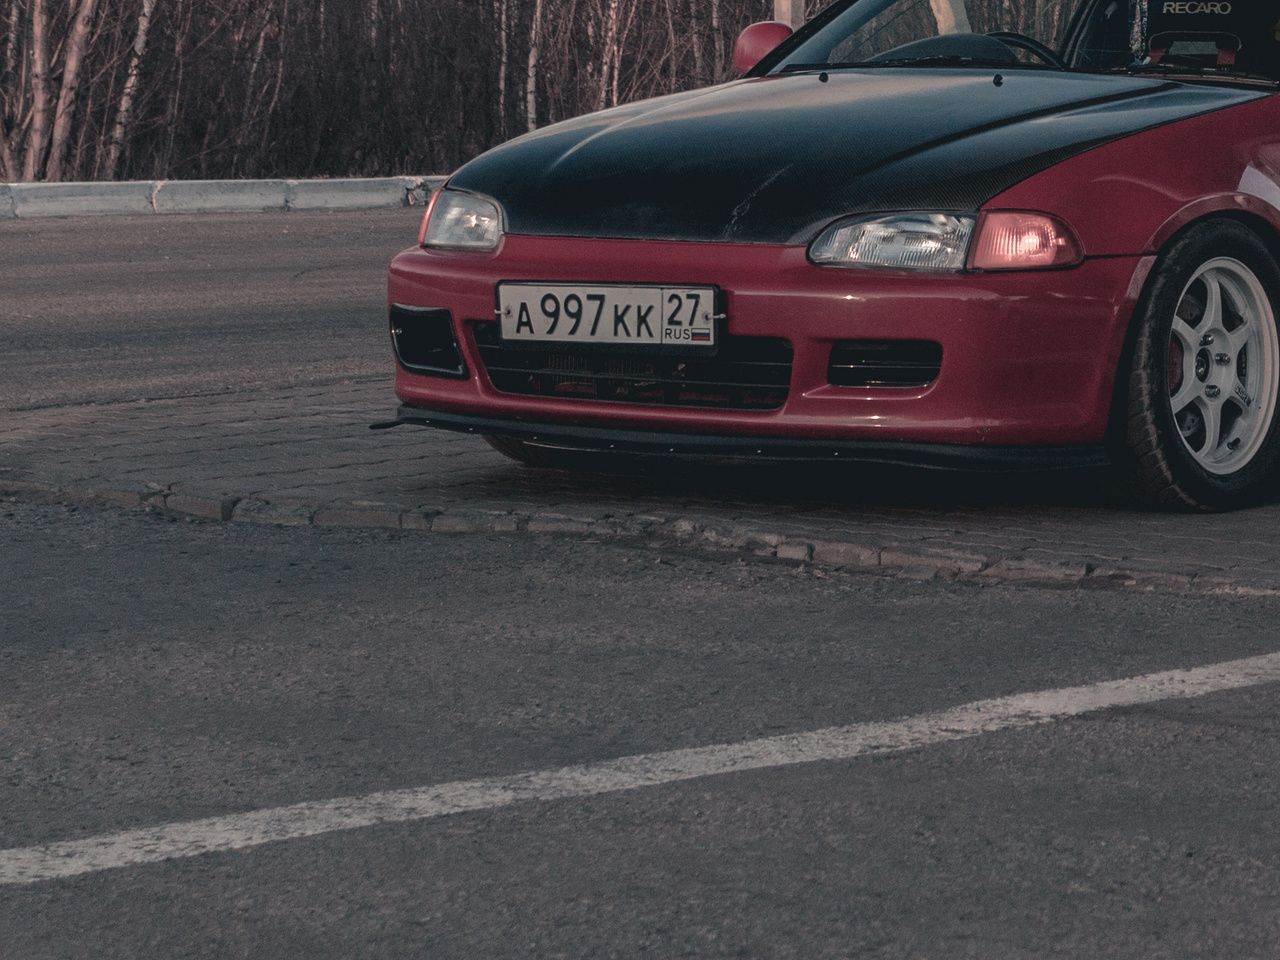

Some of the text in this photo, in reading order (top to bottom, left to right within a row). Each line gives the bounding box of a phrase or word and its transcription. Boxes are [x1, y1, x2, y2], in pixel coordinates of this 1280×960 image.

[1162, 1, 1232, 15] RECARO
[667, 293, 701, 327] 27
[664, 328, 691, 340] RUS
